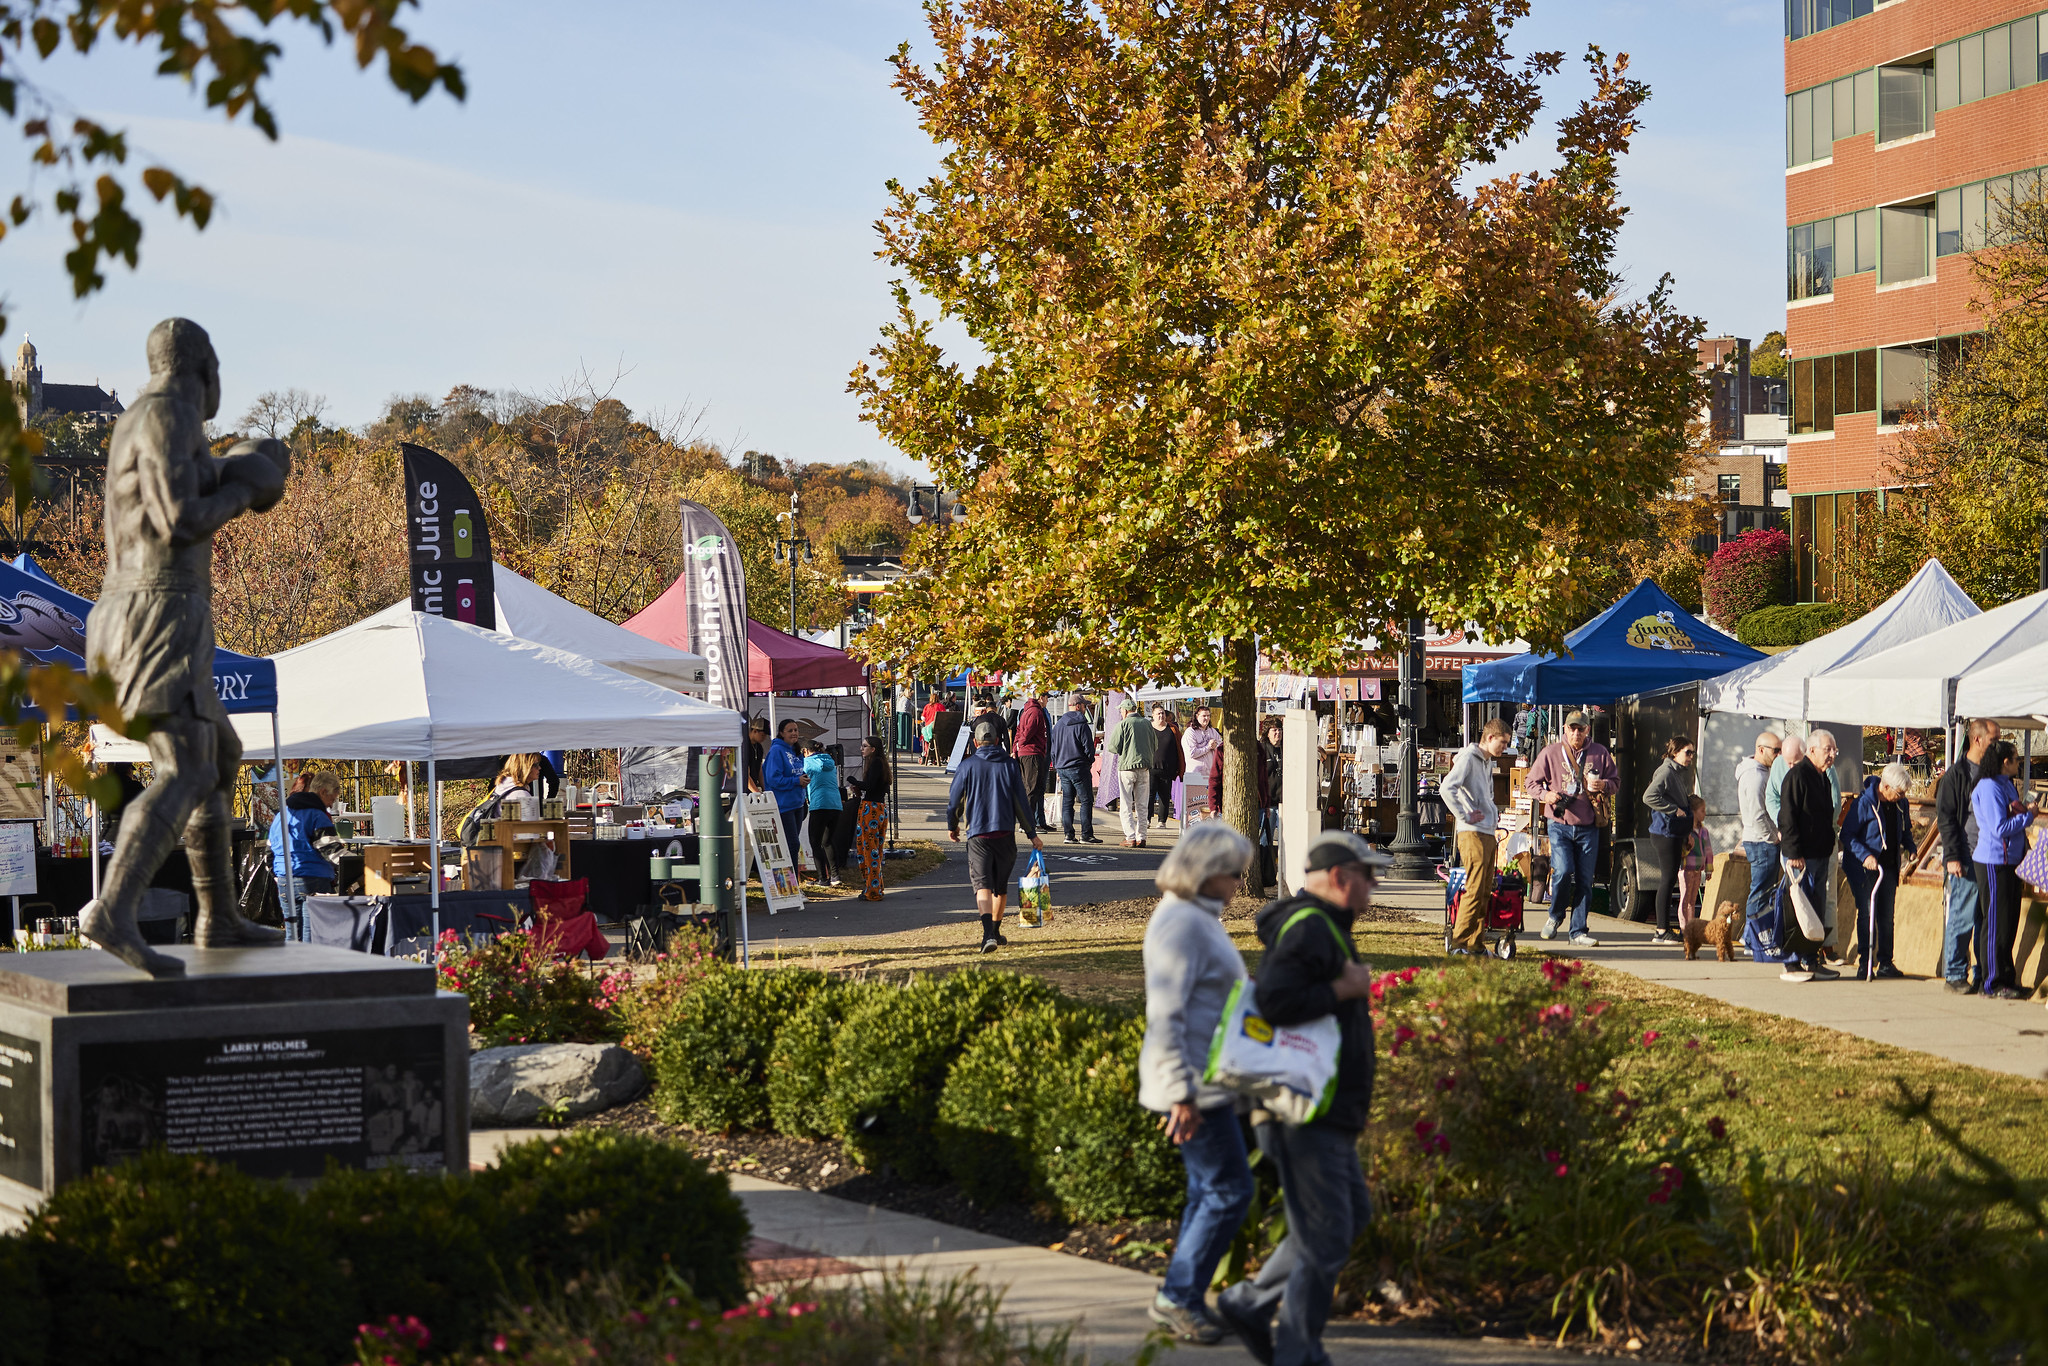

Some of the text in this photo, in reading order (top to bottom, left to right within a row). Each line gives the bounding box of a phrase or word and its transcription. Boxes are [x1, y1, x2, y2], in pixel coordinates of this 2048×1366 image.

[416, 481, 443, 617] nic Juice
[685, 543, 727, 559] Organic
[698, 565, 722, 708] moothies
[1426, 628, 1461, 646] ROASTER
[1342, 657, 1399, 669] ASTWEL
[1425, 657, 1469, 669] OFFEE
[212, 671, 253, 701] ERY
[223, 1040, 308, 1054] LARRY HOLMES
